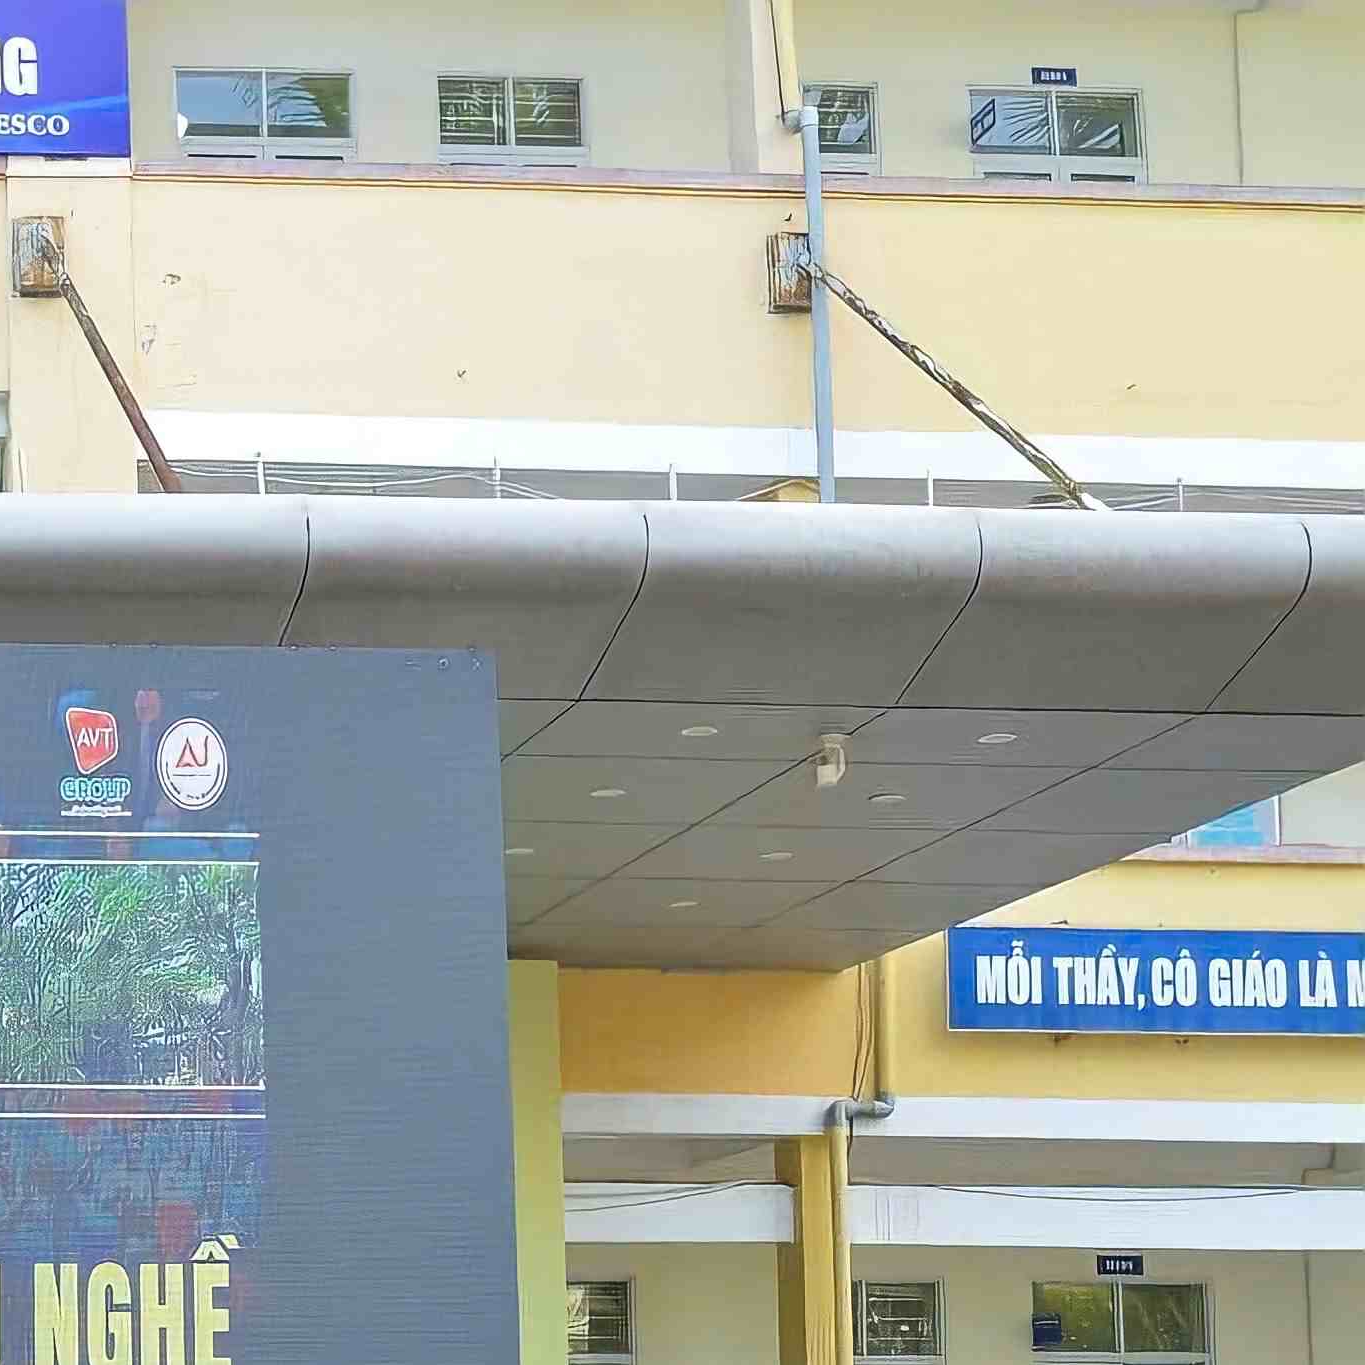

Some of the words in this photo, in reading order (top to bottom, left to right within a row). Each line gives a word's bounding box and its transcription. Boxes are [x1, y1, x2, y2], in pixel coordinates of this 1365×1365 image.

[77, 728, 114, 750] AVT
[61, 778, 131, 801] GROUP
[976, 940, 1042, 1005] MỖI
[1208, 950, 1287, 1008] GIÁO
[1299, 951, 1338, 1008] LÀ
